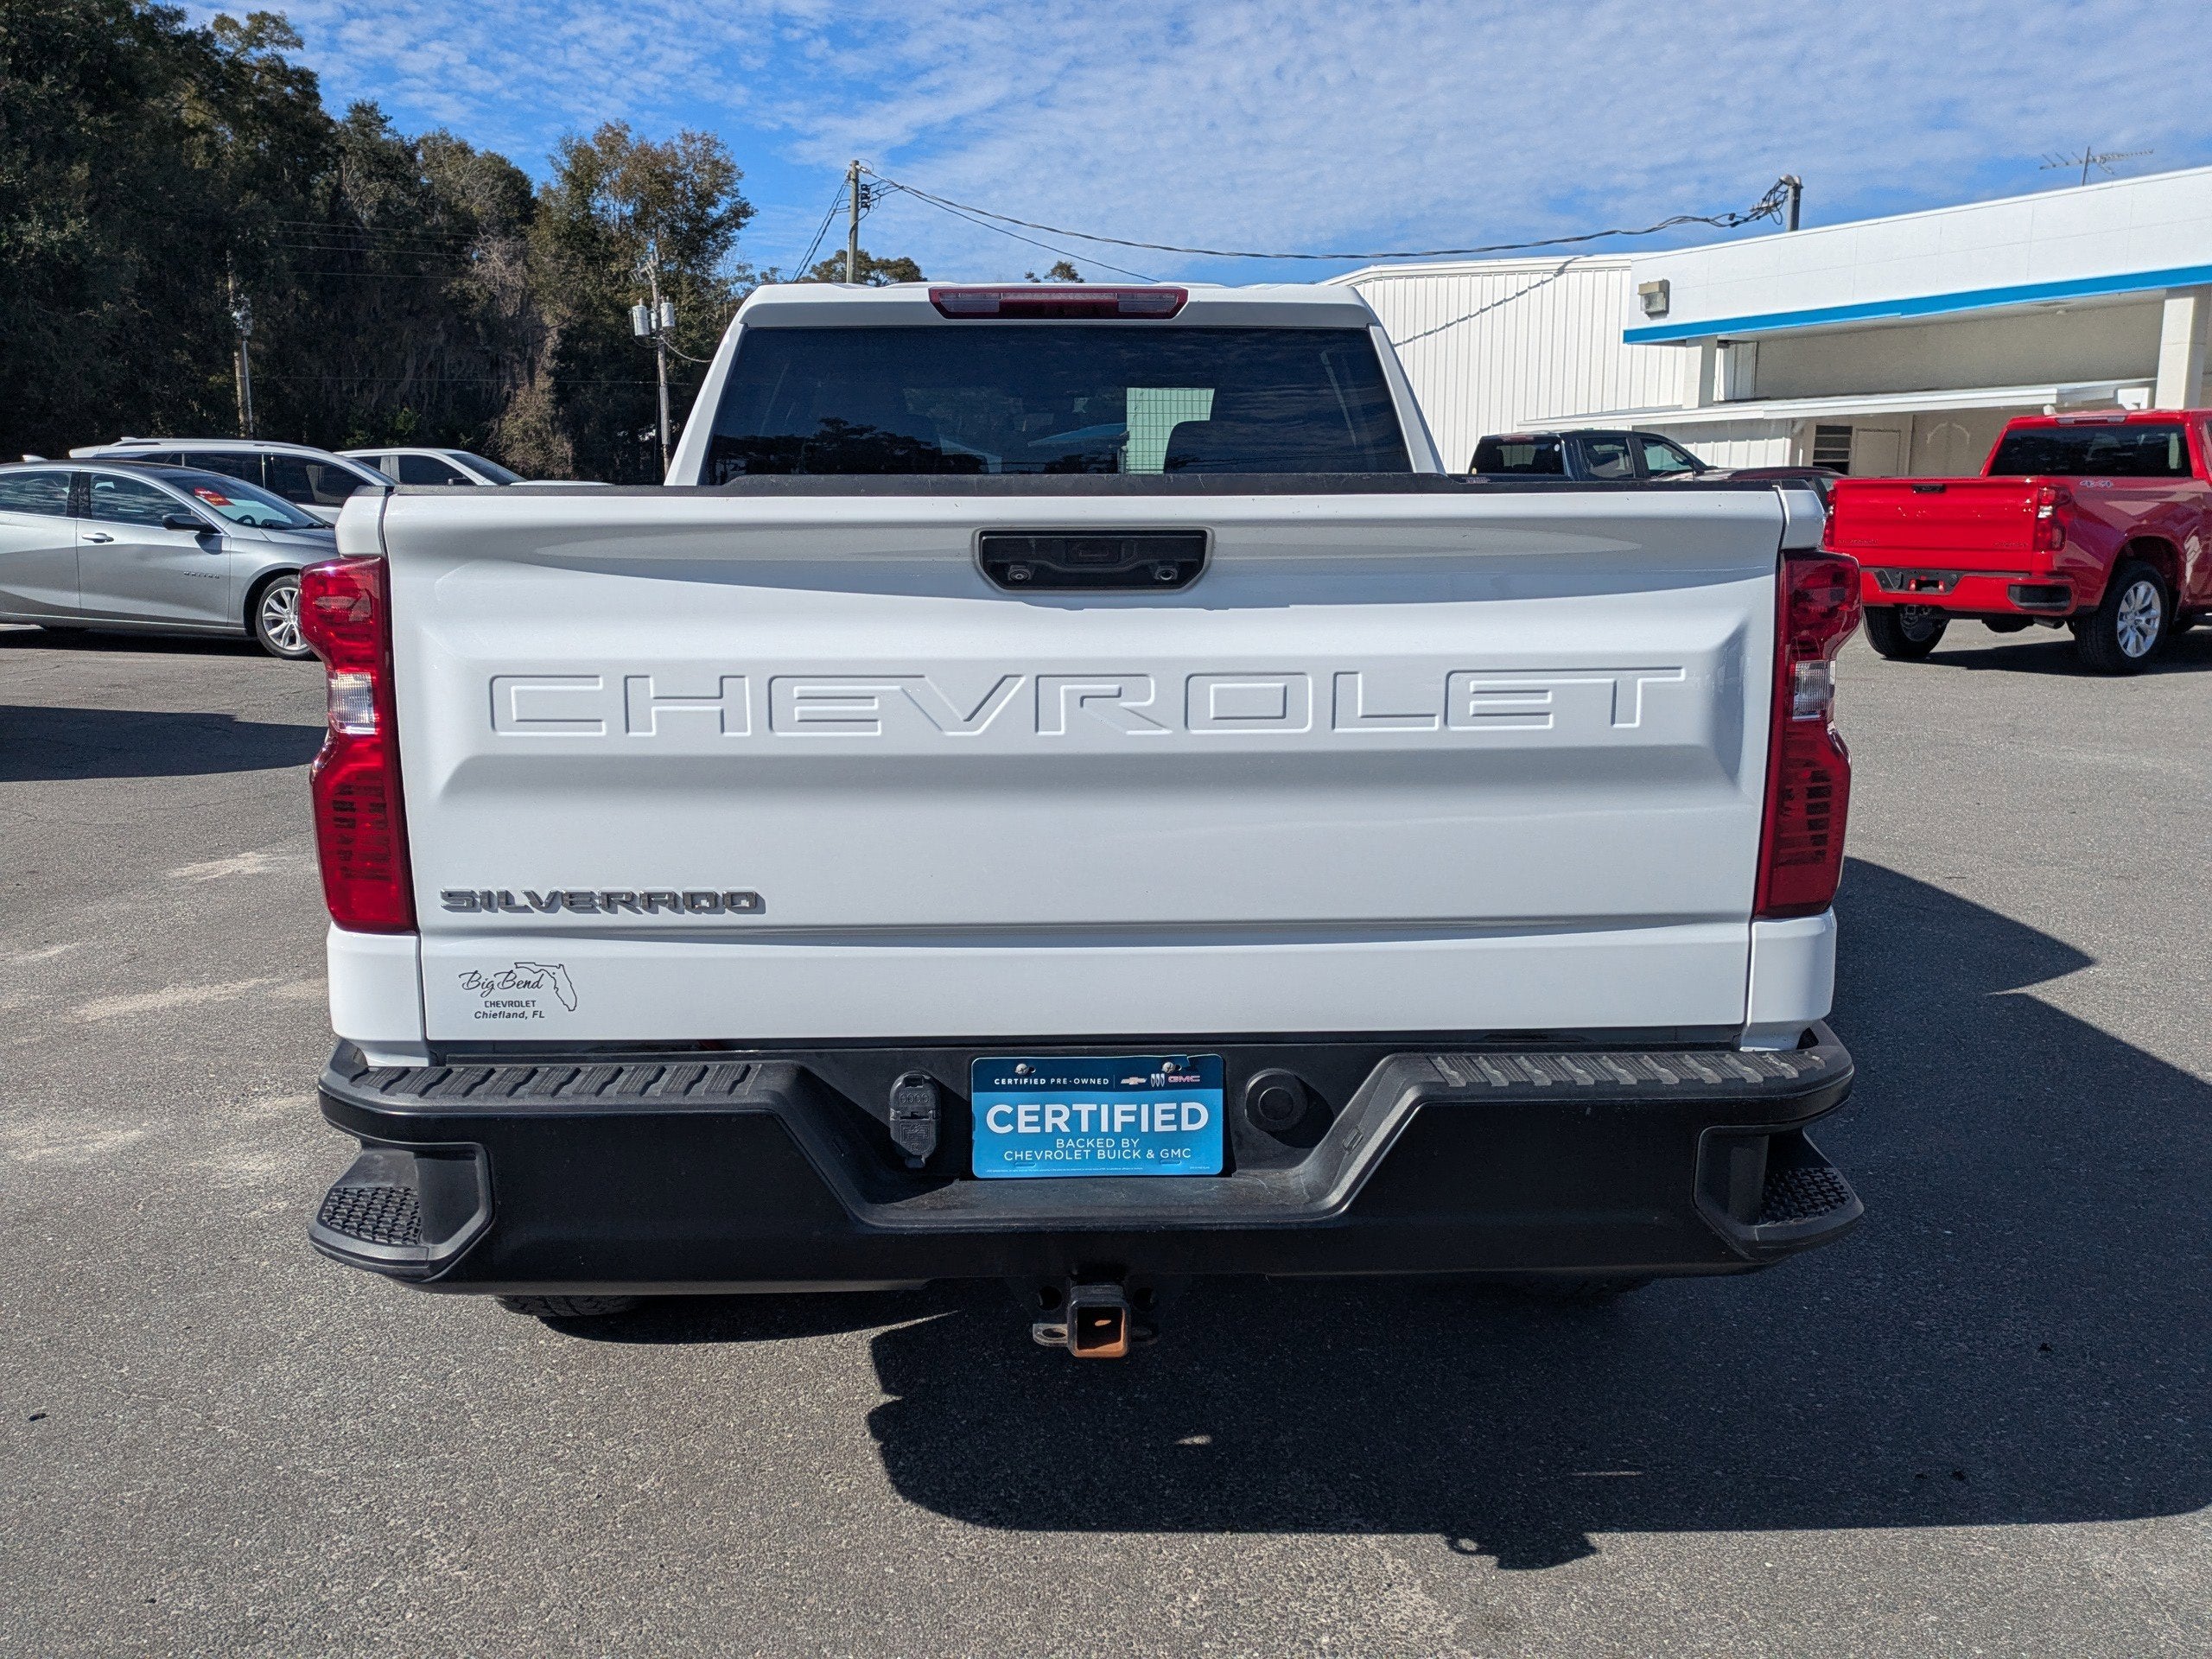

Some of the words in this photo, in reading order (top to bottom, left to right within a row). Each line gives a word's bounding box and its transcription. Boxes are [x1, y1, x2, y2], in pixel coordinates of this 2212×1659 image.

[491, 667, 1687, 737] CHEVROLET
[441, 887, 762, 912] SILVERADO
[458, 969, 495, 998] Big
[493, 969, 544, 990] Bend
[484, 1000, 537, 1008] CHEVROLET
[474, 1010, 529, 1020] Chiefland,
[531, 1010, 545, 1019] FL
[1167, 1075, 1200, 1084] GMC
[986, 1102, 1210, 1134] CERTIFIED
[1056, 1138, 1116, 1149] BACKED
[1122, 1138, 1140, 1148] BY
[1003, 1149, 1090, 1161] CHEVROLET
[1096, 1149, 1141, 1160] BUICK
[1146, 1149, 1155, 1160] &
[1160, 1148, 1192, 1159] GMC
